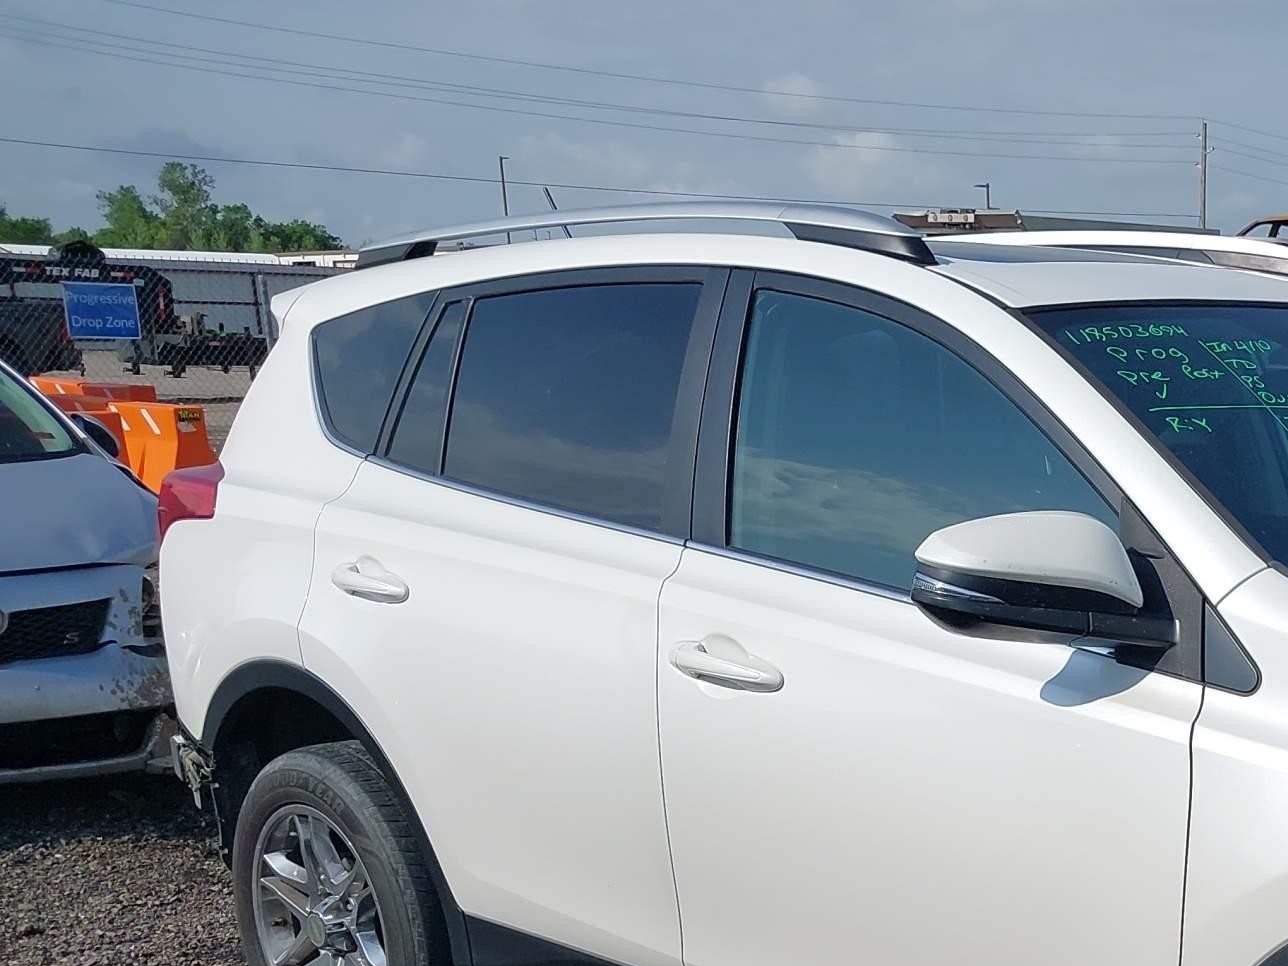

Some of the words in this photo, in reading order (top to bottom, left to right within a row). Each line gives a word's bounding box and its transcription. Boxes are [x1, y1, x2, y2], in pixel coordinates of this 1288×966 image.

[45, 266, 70, 276] TEX
[75, 268, 99, 278] FAB
[66, 291, 136, 306] Progressive
[72, 316, 103, 329] Drop
[106, 317, 136, 328] Zone
